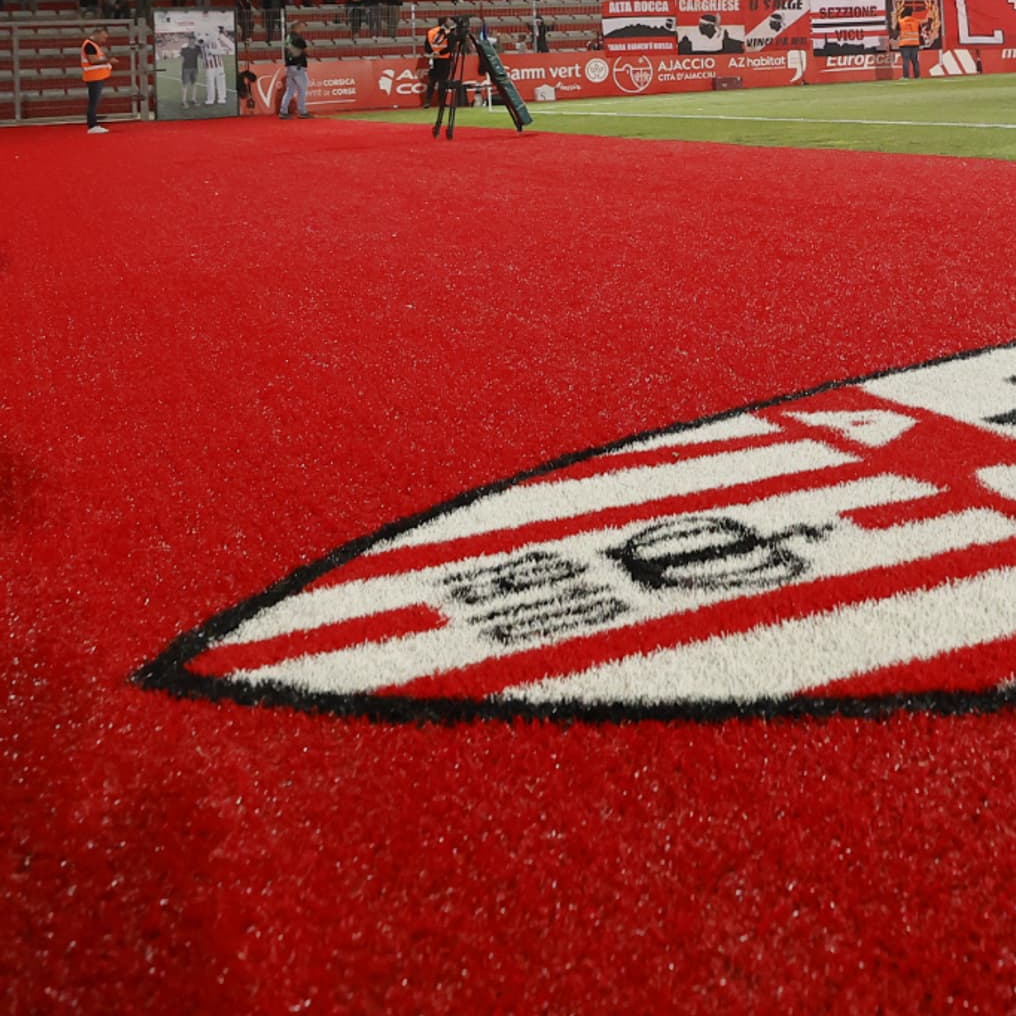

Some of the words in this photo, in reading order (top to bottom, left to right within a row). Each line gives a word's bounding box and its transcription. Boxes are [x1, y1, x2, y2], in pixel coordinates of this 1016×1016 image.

[609, 0, 632, 13] ALTA
[819, 5, 877, 19] SEZZIONE
[835, 29, 864, 42] VICU
[550, 63, 582, 78] vert
[658, 57, 716, 71] AJACCIO
